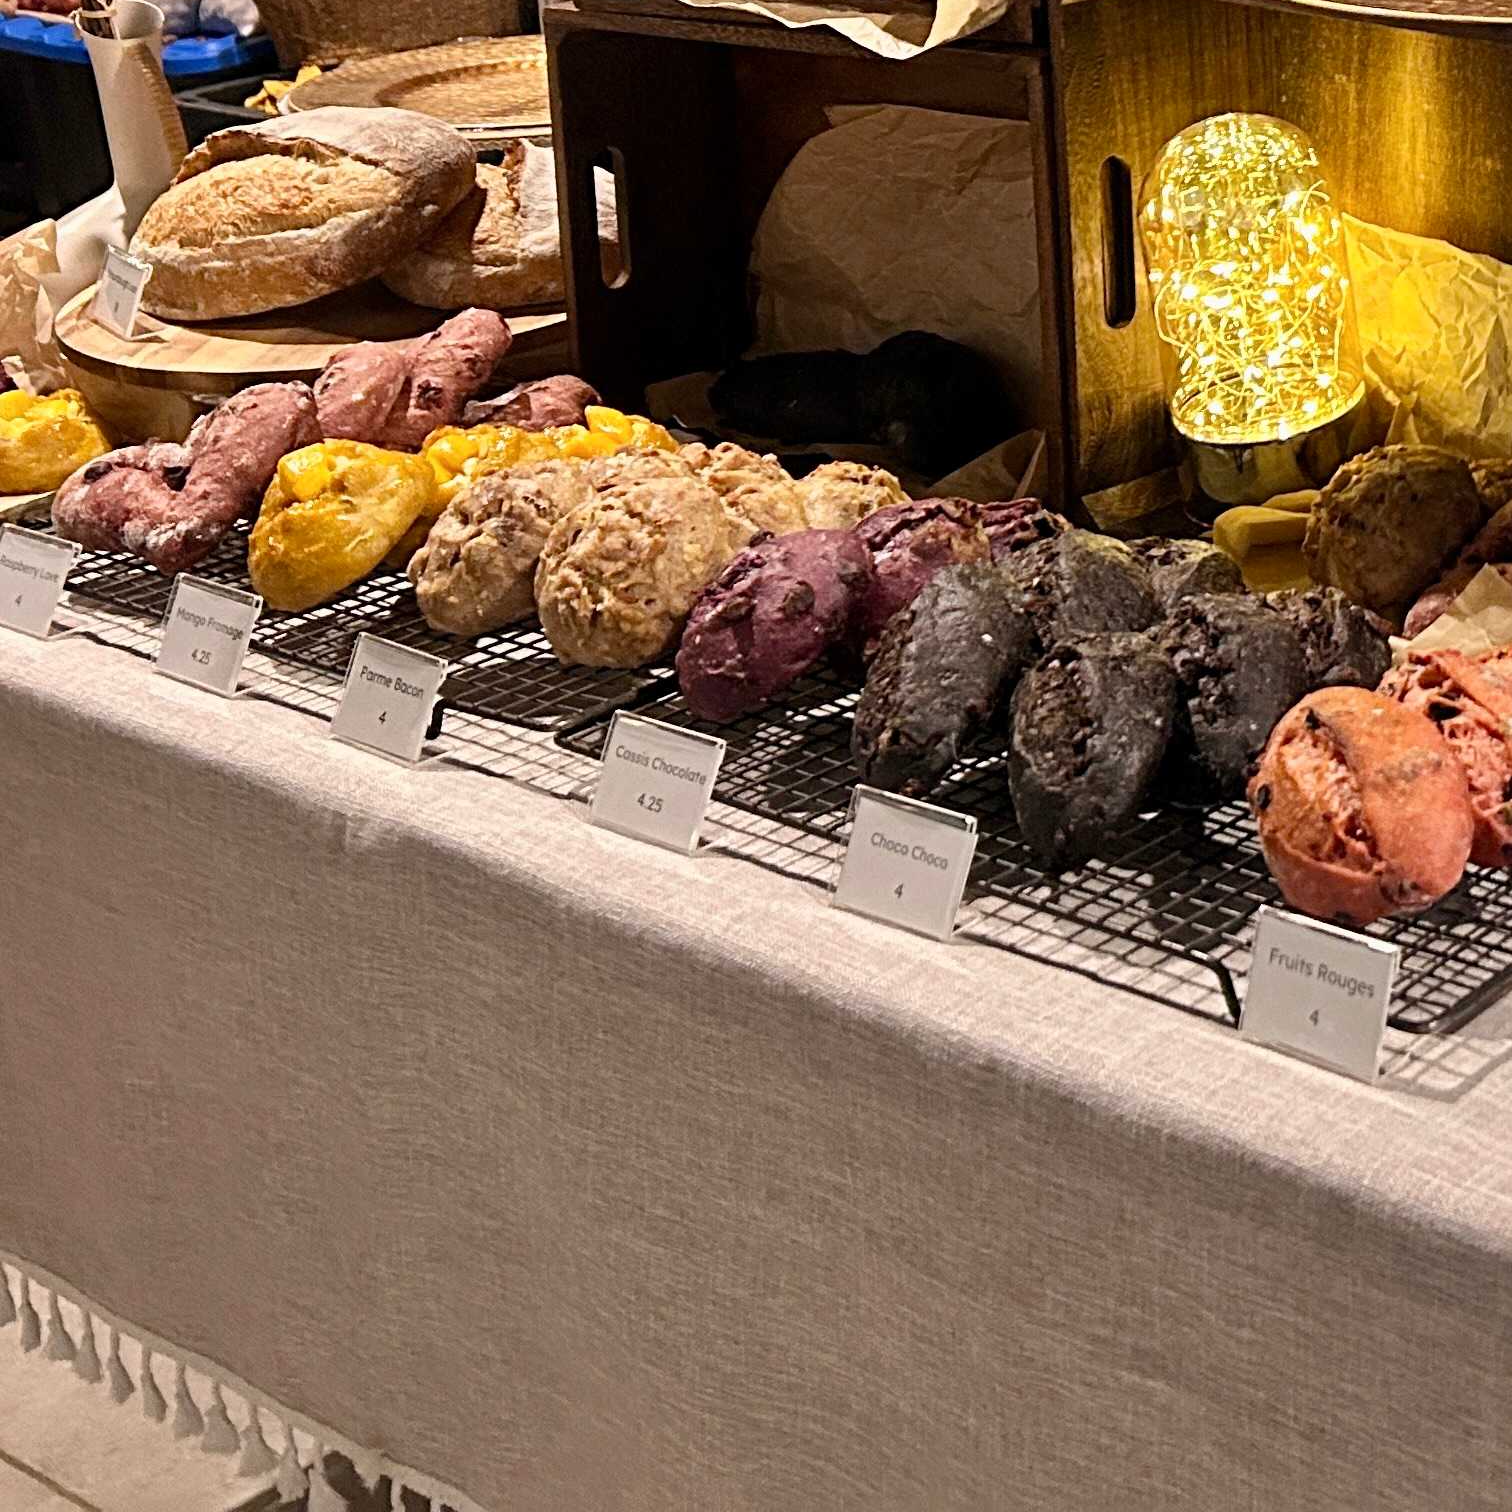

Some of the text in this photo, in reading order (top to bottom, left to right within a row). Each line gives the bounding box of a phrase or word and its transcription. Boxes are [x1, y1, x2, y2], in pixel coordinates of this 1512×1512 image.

[360, 664, 424, 700] Parme Bacon
[378, 710, 388, 725] 4
[615, 744, 708, 786] Cassis Chocolate
[636, 792, 664, 814] 4.25
[870, 830, 949, 871] Choco Choco
[893, 882, 904, 900] 4
[1268, 947, 1376, 1000] Fruits Rouges
[1308, 1008, 1320, 1027] 4
